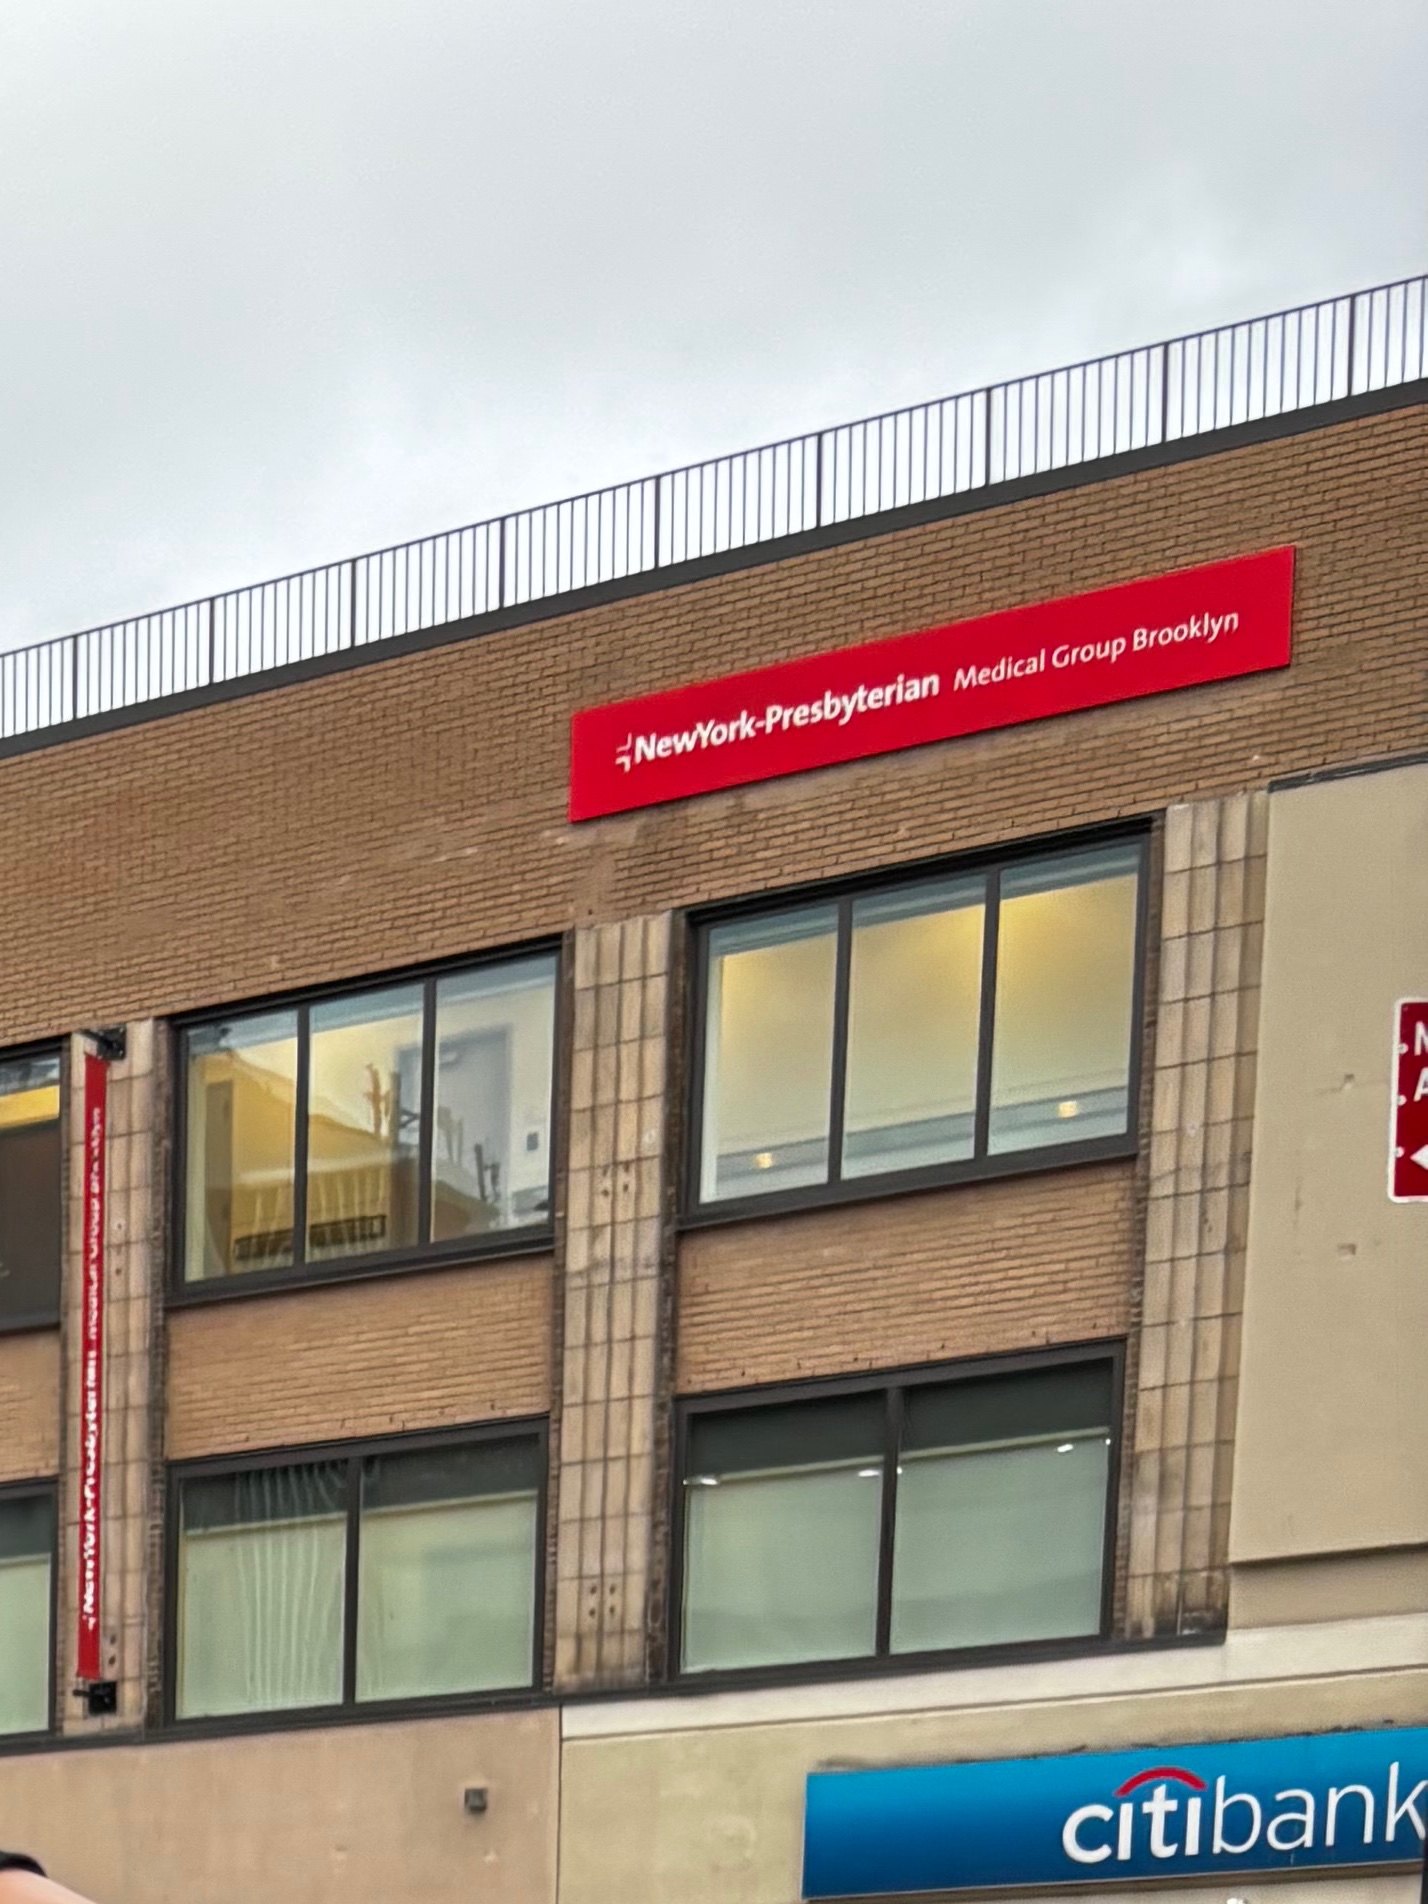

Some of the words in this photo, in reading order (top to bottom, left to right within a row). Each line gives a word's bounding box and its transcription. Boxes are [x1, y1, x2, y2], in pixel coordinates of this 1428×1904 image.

[634, 673, 940, 764] NewYork-Presbyterian
[953, 648, 1045, 692] Medical
[1051, 636, 1126, 664] Group
[1133, 612, 1239, 652] Brooklyn
[1062, 1762, 1428, 1864] citibank
